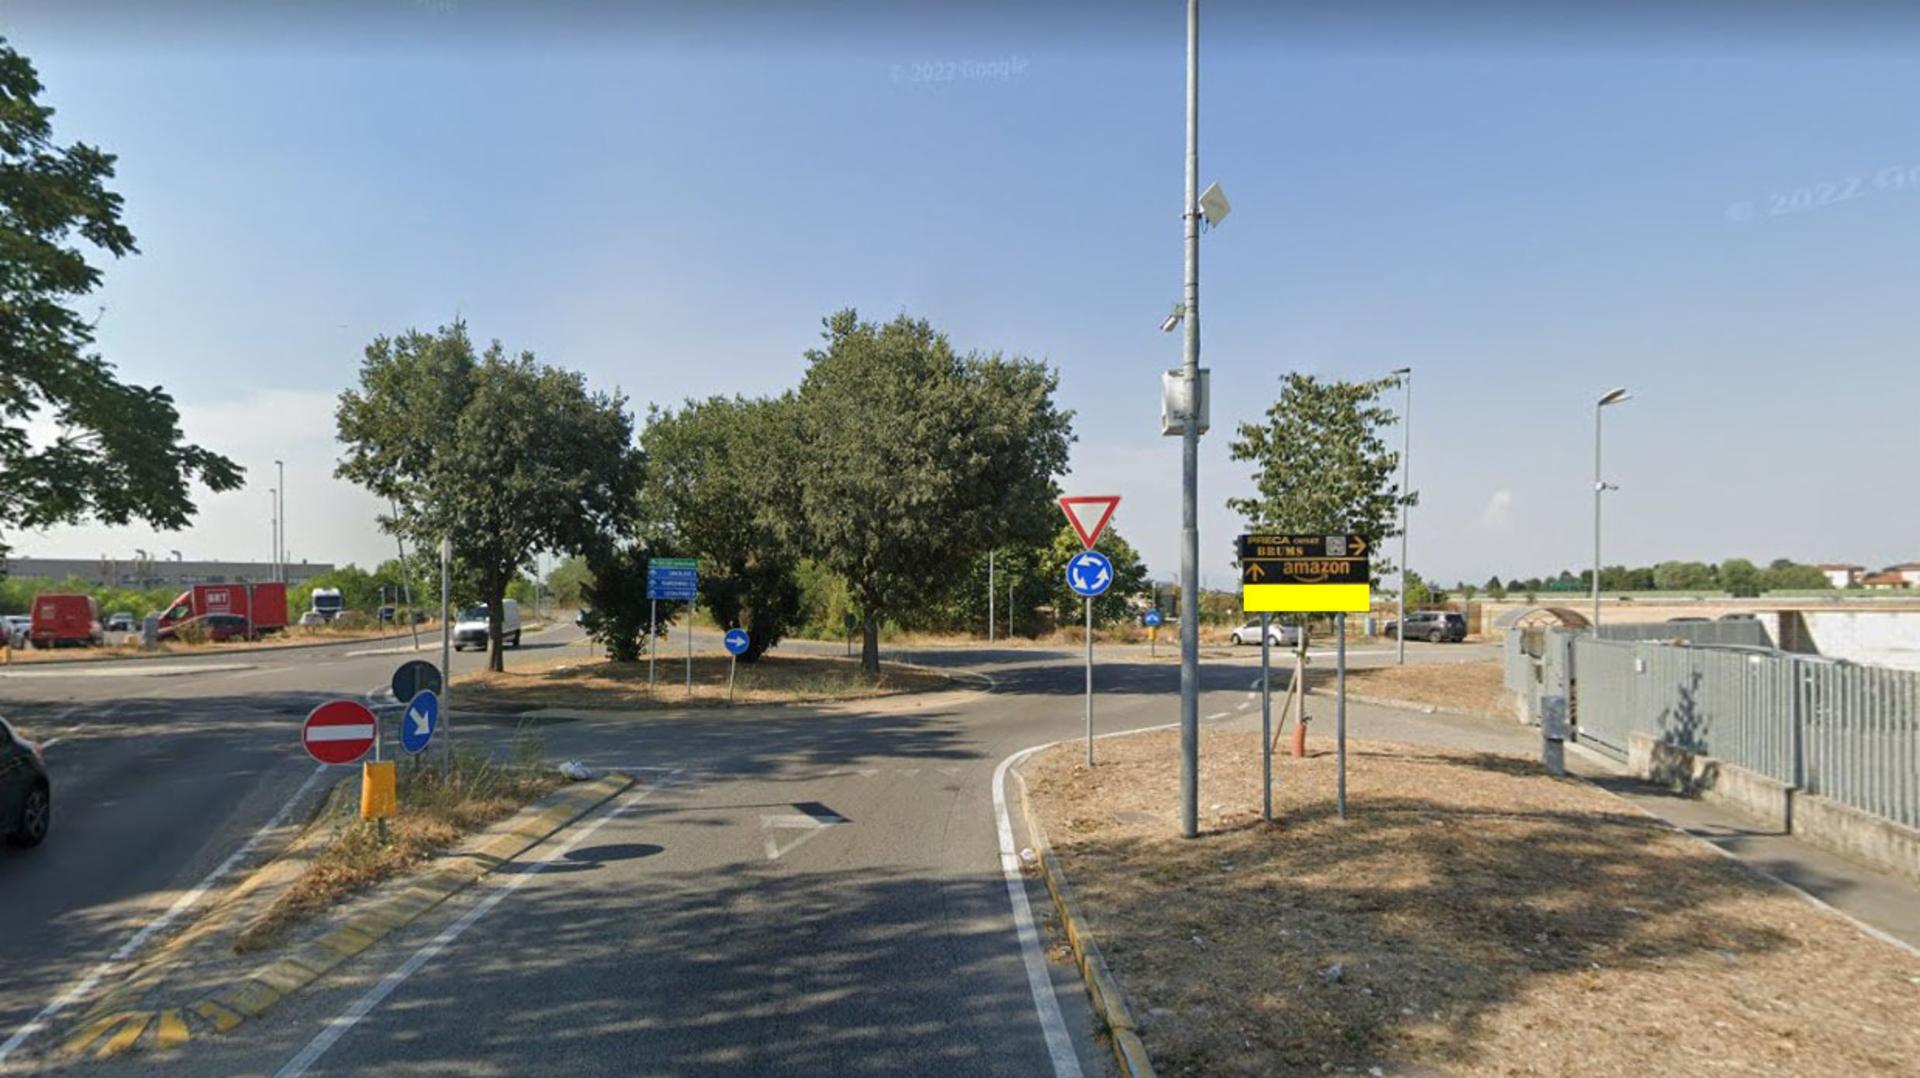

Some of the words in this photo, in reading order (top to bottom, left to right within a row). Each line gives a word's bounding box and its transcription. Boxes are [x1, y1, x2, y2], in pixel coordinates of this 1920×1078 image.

[1247, 536, 1290, 545] PRECA
[1257, 546, 1304, 556] BRUMS
[1282, 561, 1350, 575] amazon
